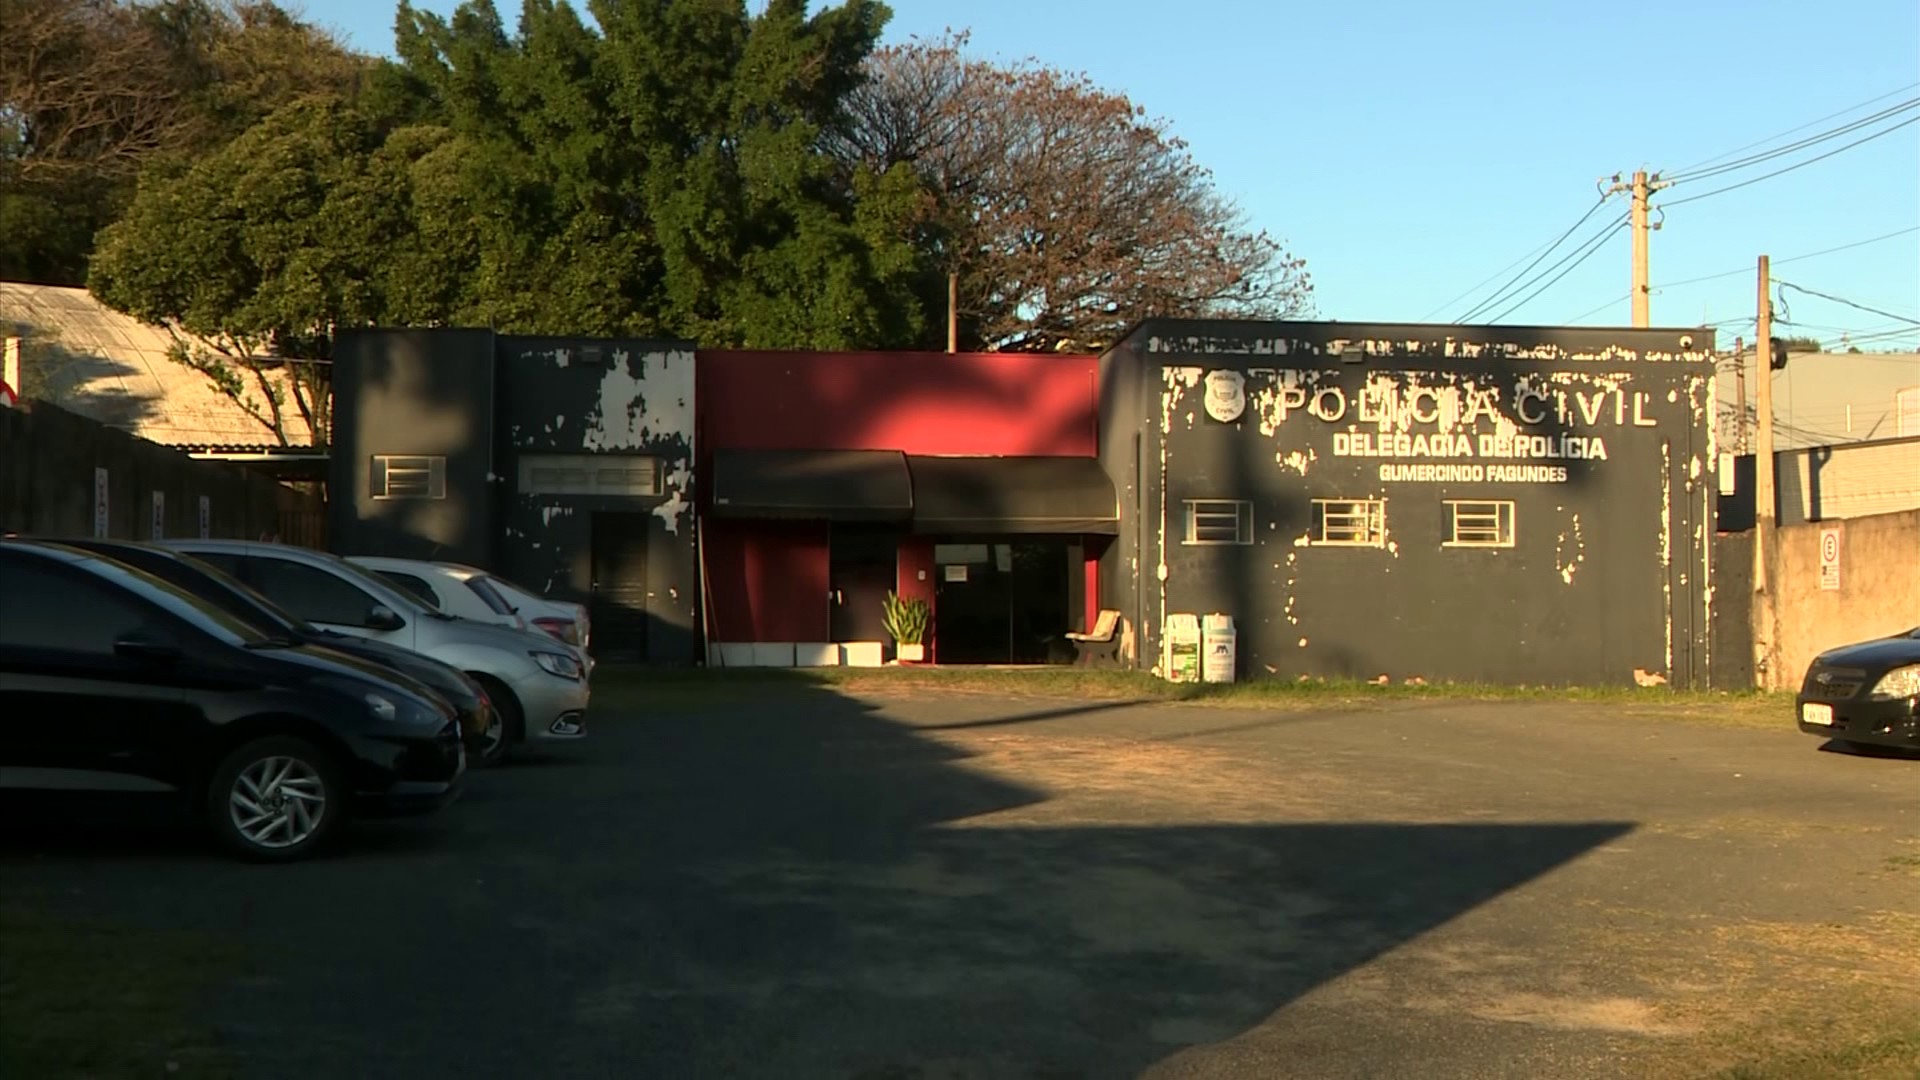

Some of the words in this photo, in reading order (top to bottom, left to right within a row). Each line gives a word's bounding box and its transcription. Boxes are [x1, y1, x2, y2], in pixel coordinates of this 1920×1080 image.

[1517, 390, 1657, 426] CIVIL
[1333, 433, 1473, 458] DELEGACIA
[1478, 434, 1512, 459] DE
[1514, 432, 1608, 460] POLÍCIA
[1379, 464, 1484, 482] GUMERCINDO
[1486, 465, 1567, 483] FAGUNDES
